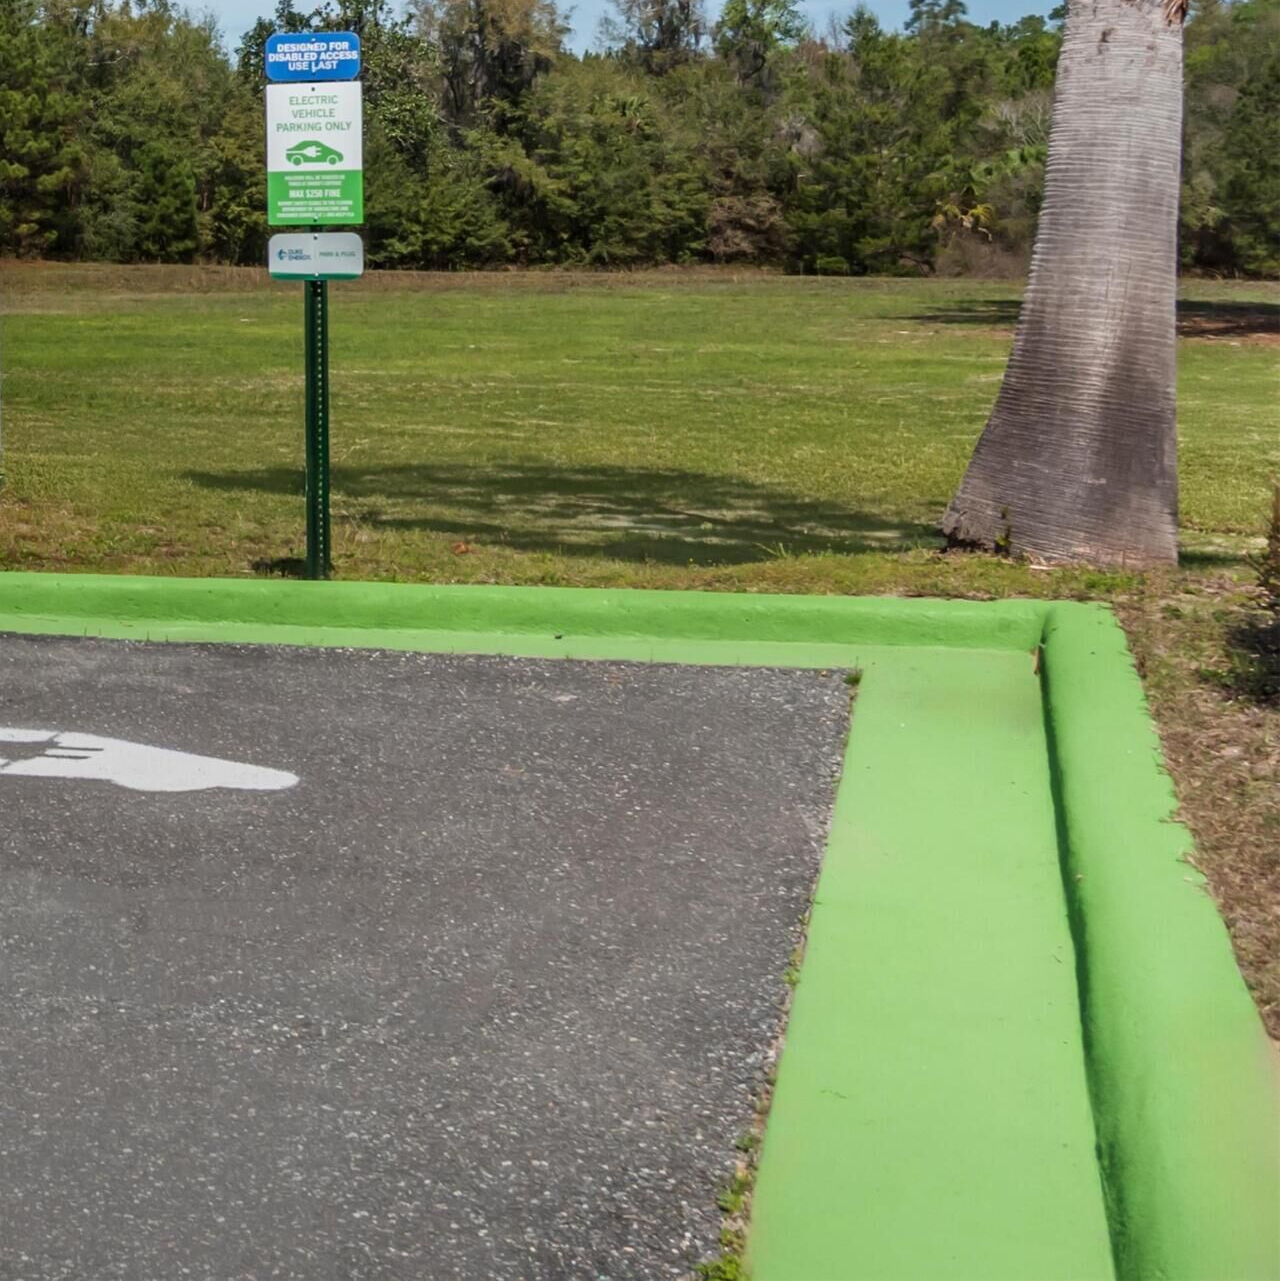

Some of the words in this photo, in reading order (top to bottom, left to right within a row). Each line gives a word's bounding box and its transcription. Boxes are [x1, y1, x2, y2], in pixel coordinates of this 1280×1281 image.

[276, 42, 327, 53] DESIGNED
[328, 41, 349, 51] FOR
[268, 52, 318, 62] DISABLED
[319, 50, 359, 61] ACCESS
[288, 62, 310, 71] USE
[311, 60, 339, 70] LAST
[288, 94, 339, 106] ELECTRIC
[291, 108, 336, 119] VEHICLE
[276, 122, 322, 133] PARKING
[325, 120, 352, 131] ONLY
